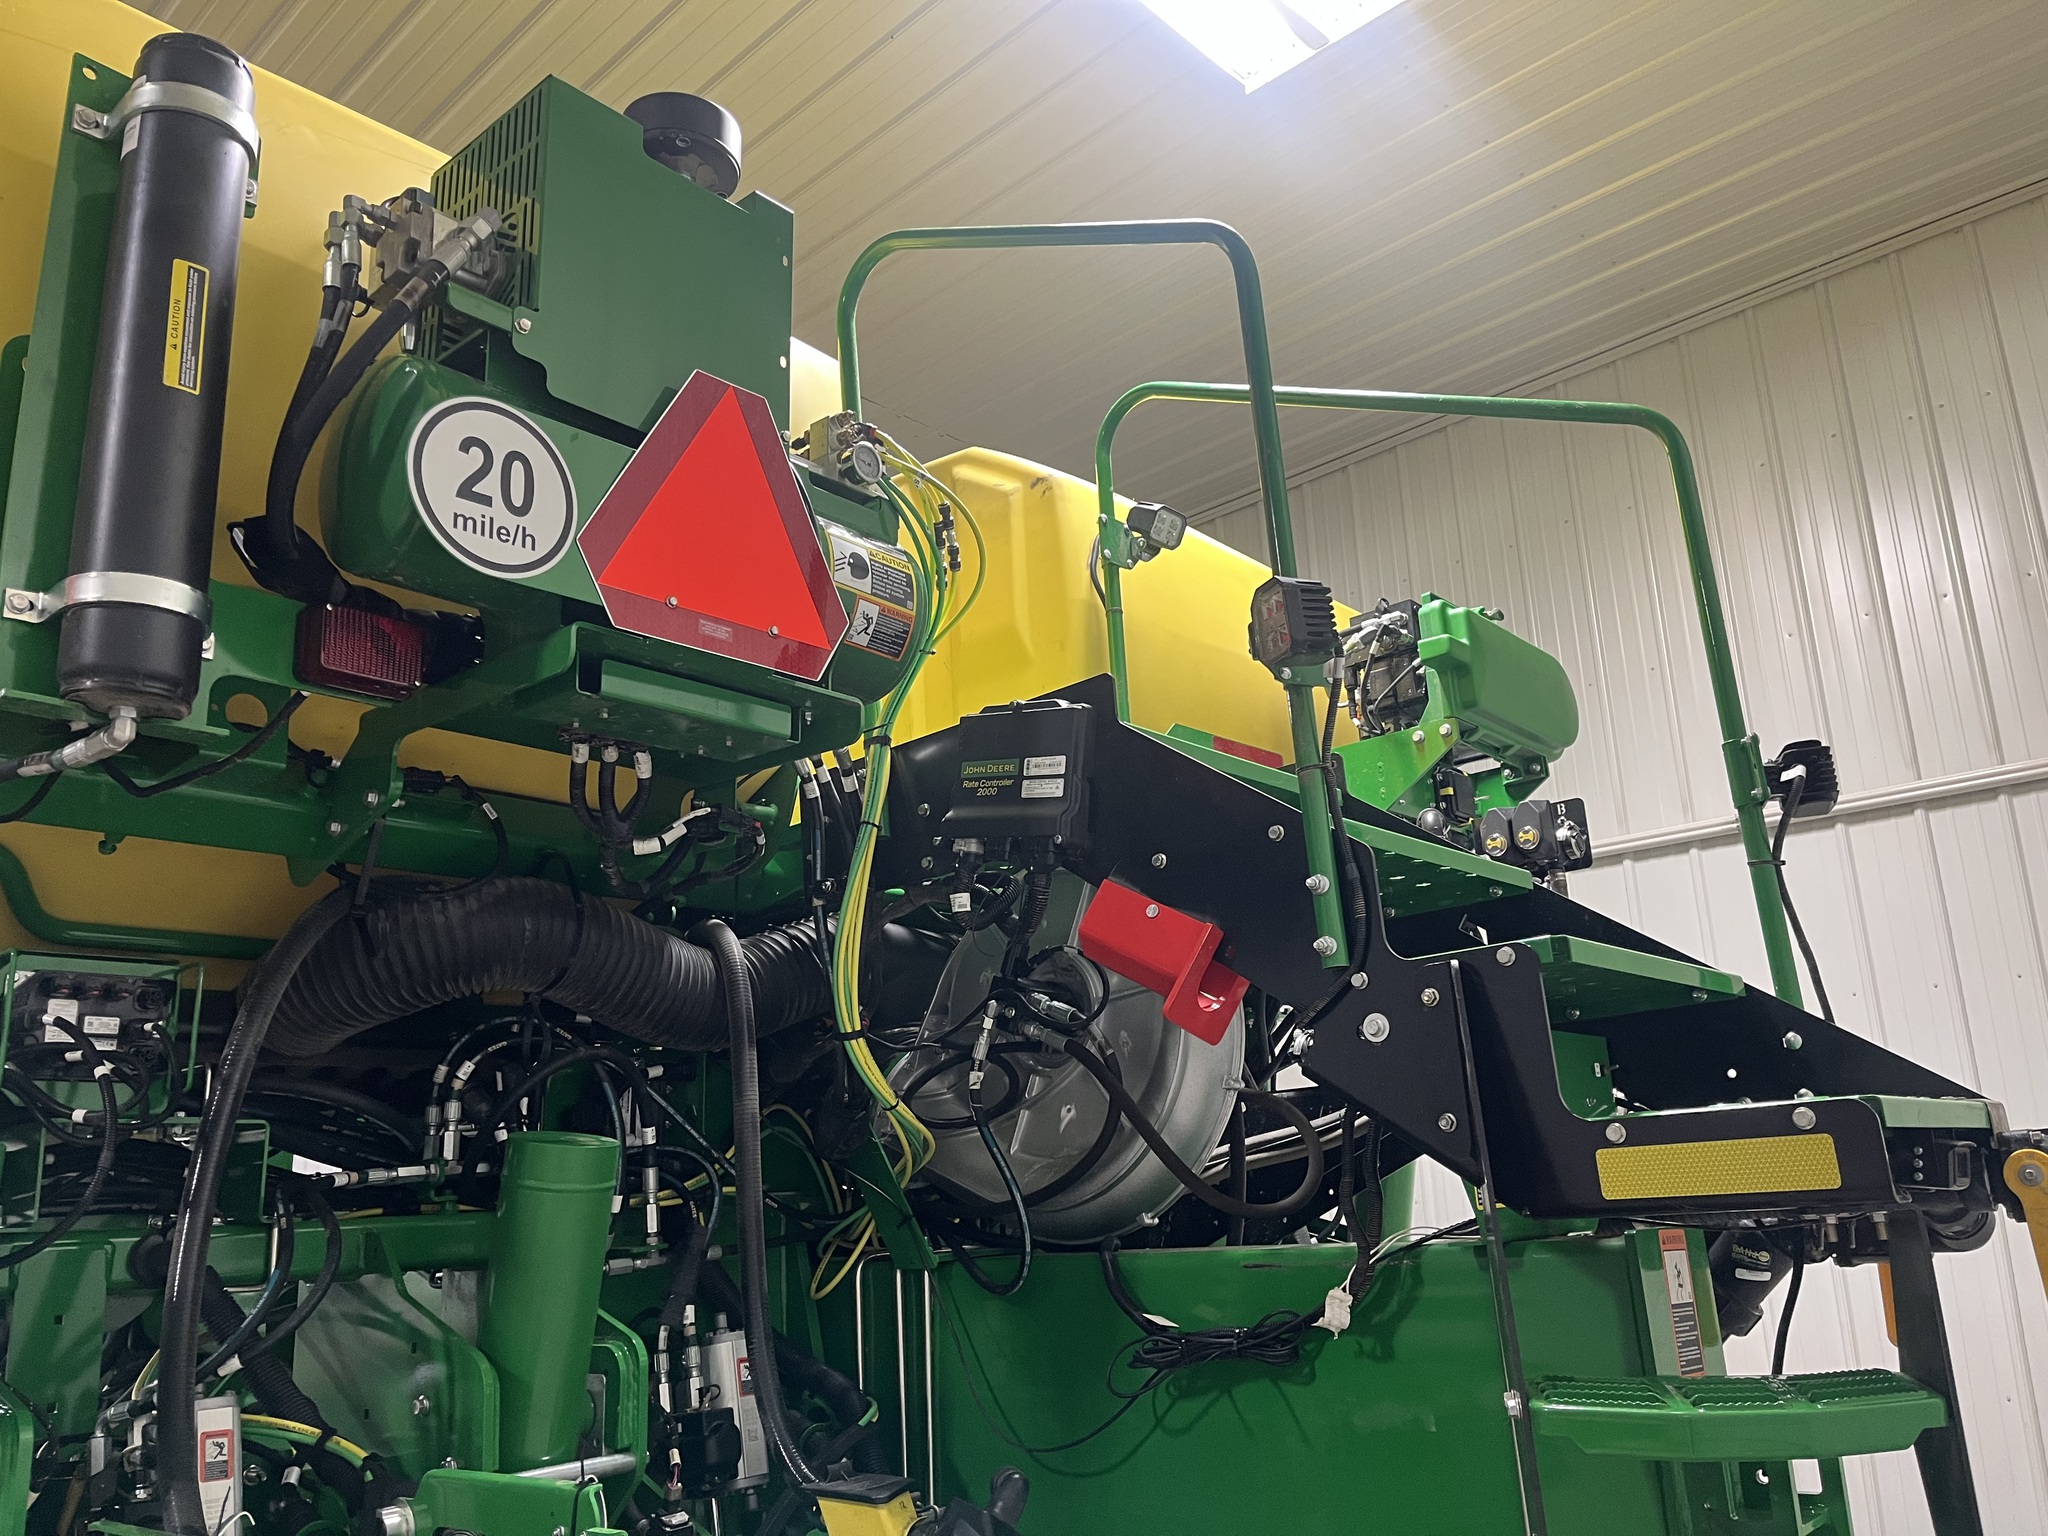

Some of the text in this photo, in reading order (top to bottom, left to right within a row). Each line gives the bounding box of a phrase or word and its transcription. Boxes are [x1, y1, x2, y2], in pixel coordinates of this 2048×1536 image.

[170, 299, 181, 339] CAUTION
[455, 436, 535, 518] 20
[453, 512, 536, 551] mile/h
[875, 553, 911, 572] CAUTION
[886, 609, 913, 623] WARNING
[963, 765, 986, 775] JOHN
[986, 764, 1015, 773] DEERE
[962, 780, 979, 788] Rate
[979, 779, 1015, 788] Controller
[976, 787, 998, 796] 2000
